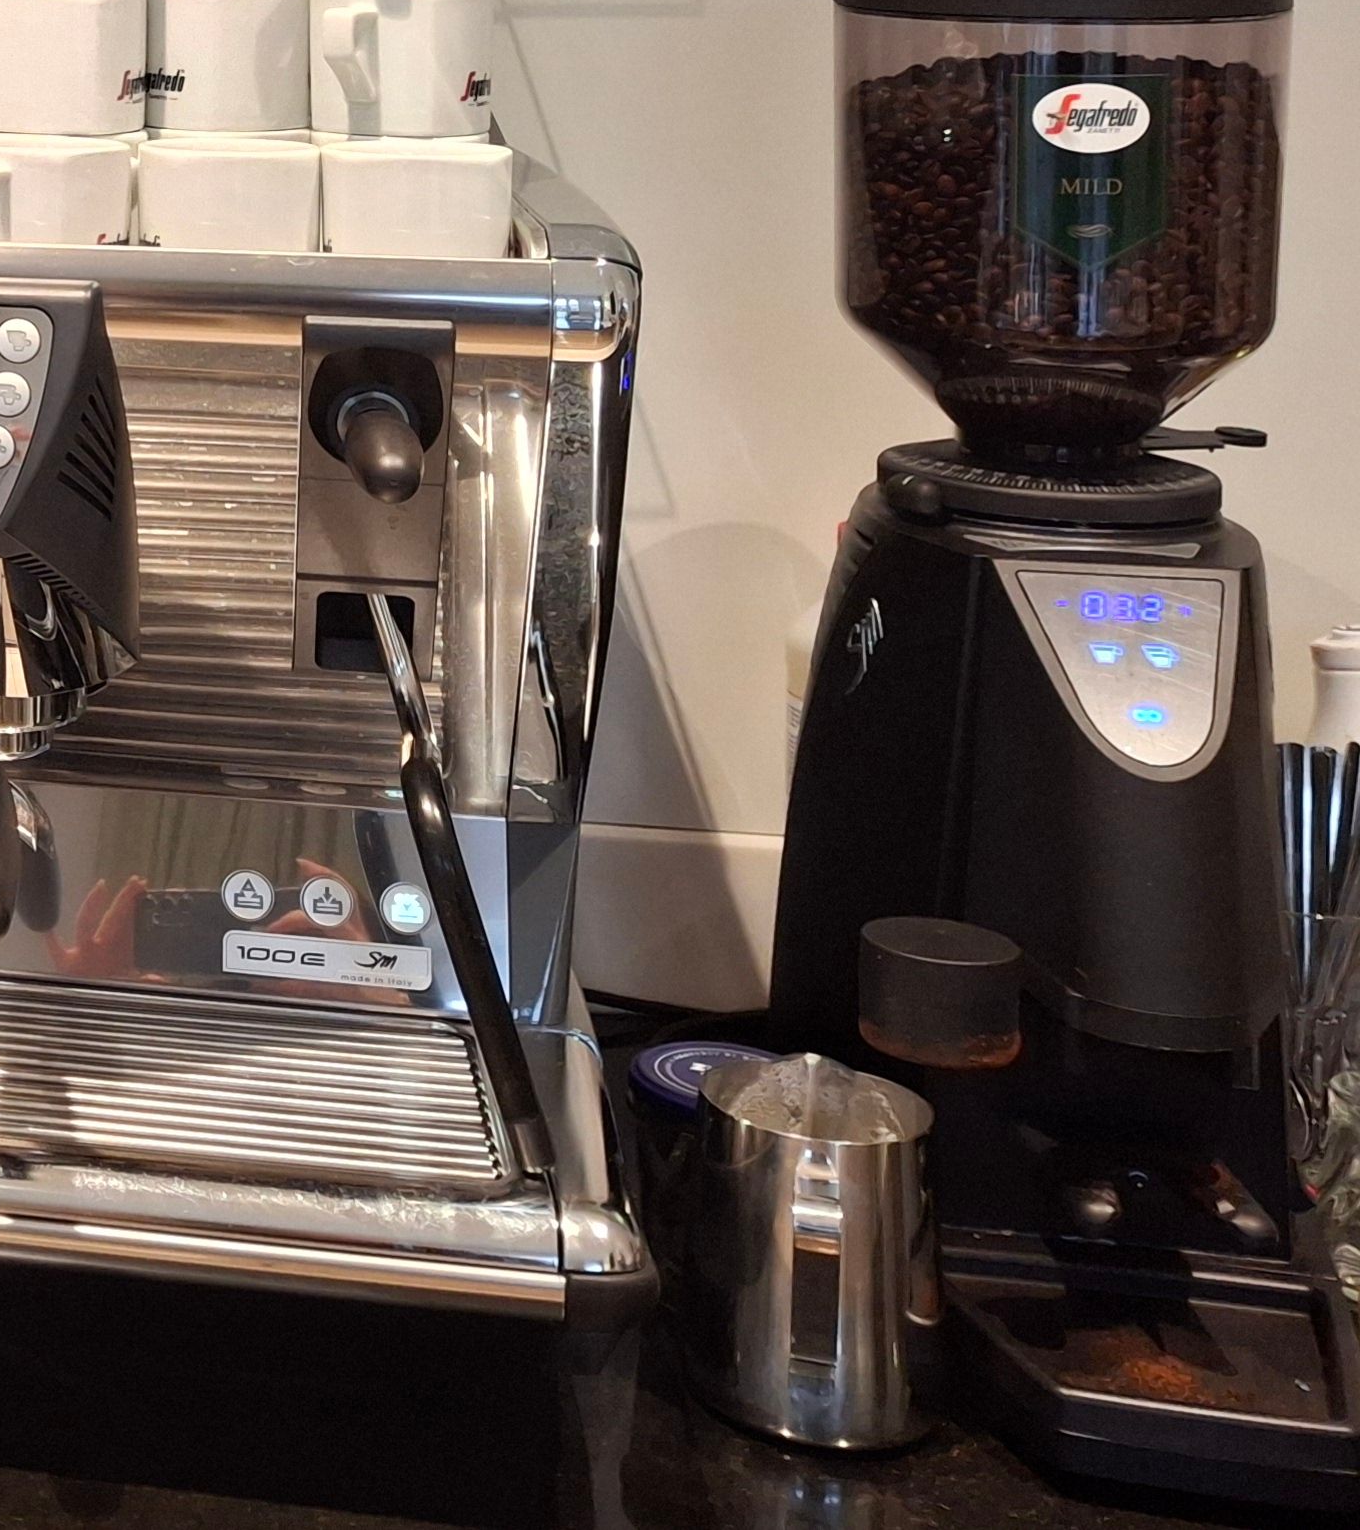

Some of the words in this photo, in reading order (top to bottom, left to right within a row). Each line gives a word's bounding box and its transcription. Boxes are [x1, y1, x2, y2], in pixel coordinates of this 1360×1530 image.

[1044, 93, 1139, 135] Segafredo
[1060, 177, 1123, 196] MILD
[340, 973, 371, 983] made
[374, 976, 385, 984] in
